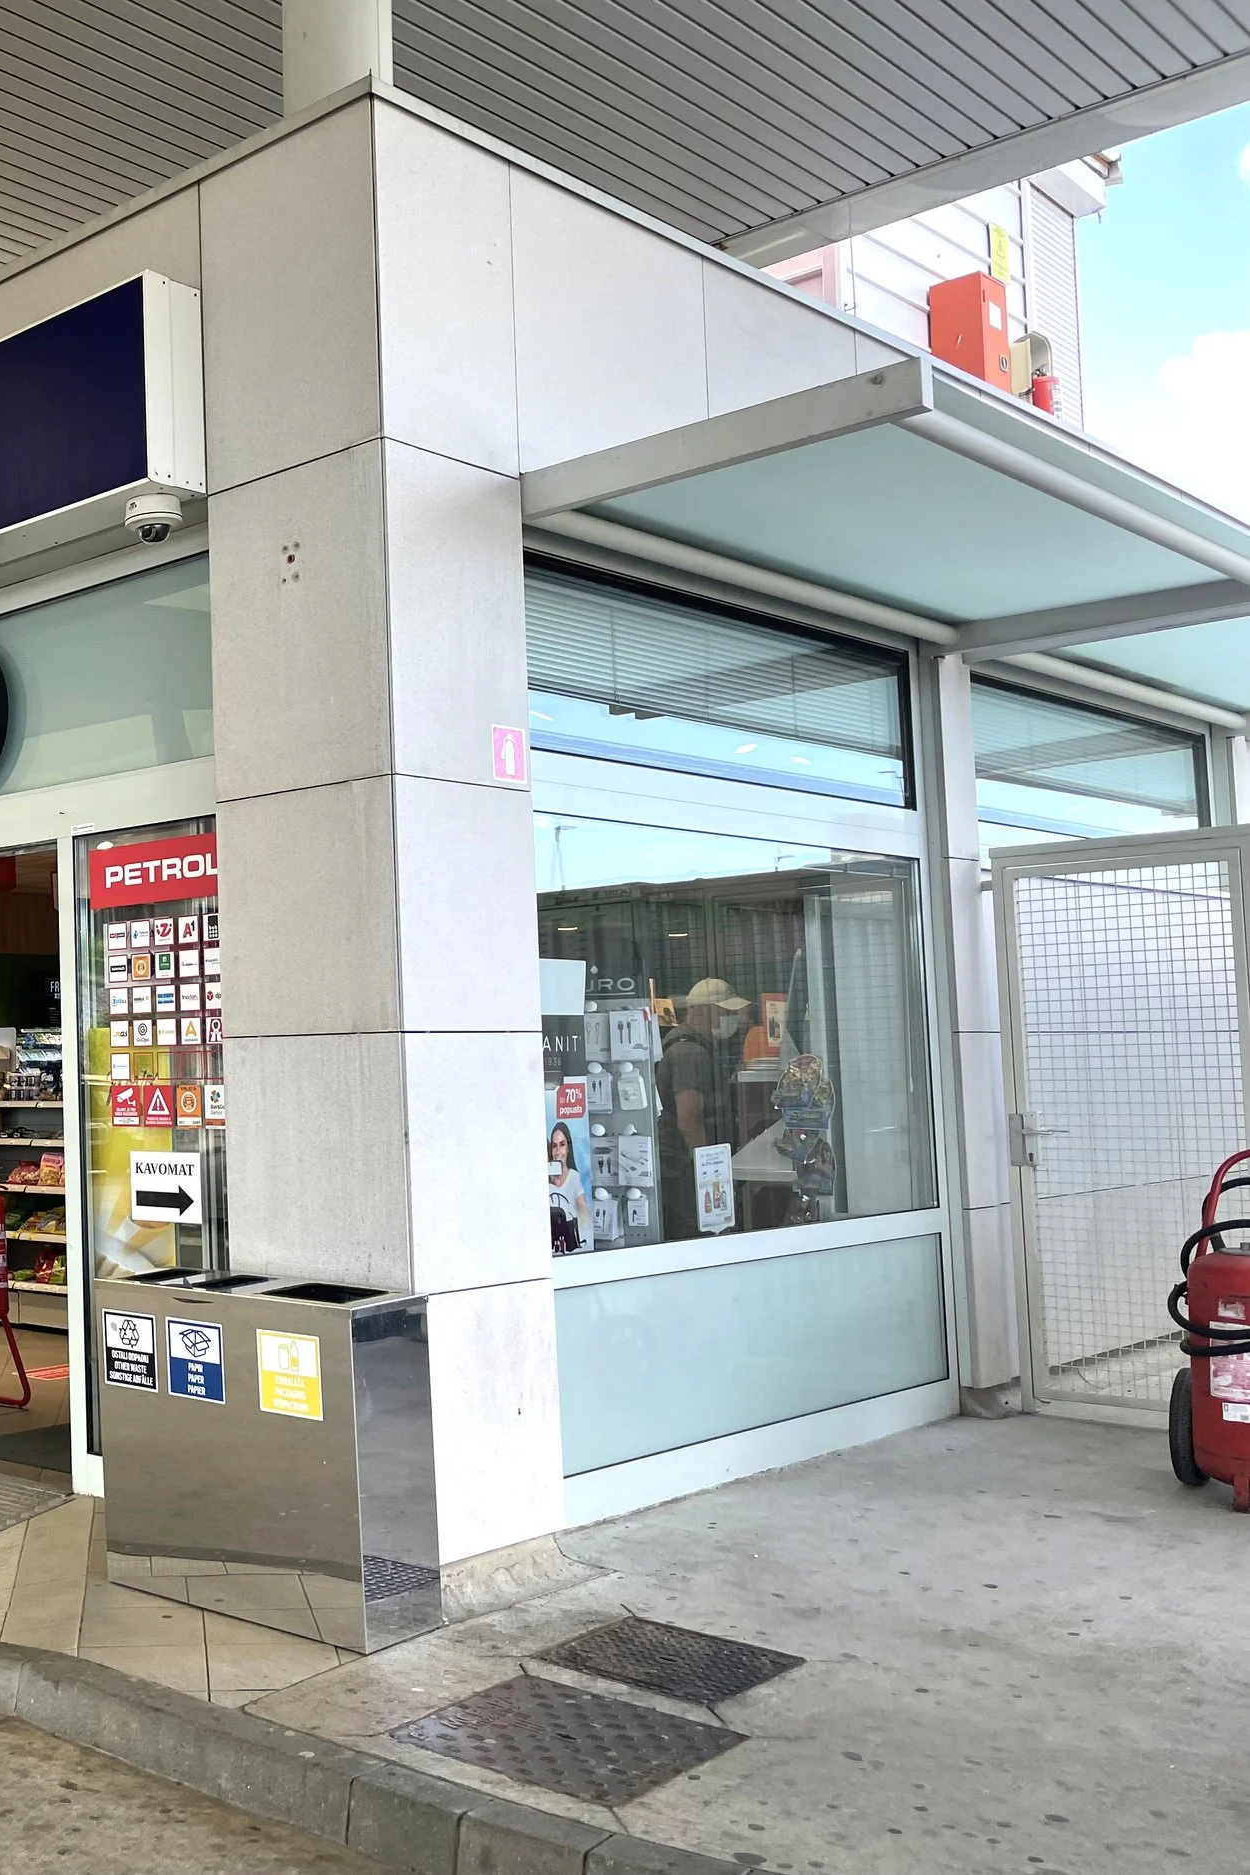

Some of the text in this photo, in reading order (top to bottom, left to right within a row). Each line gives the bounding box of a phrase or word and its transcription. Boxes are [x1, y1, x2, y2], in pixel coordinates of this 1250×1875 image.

[105, 852, 218, 889] PETROL
[183, 920, 195, 938] A1
[565, 1088, 583, 1104] 70%
[559, 1105, 583, 1116] popusta
[135, 1162, 195, 1176] KAVOMAT
[111, 1349, 129, 1361] OSTALI
[114, 1361, 147, 1375] OTHER WASTE
[187, 1362, 204, 1373] PAPIR
[109, 1370, 132, 1383] SONSTIGE
[187, 1373, 205, 1384] PAPER
[187, 1384, 206, 1396] PAPIER
